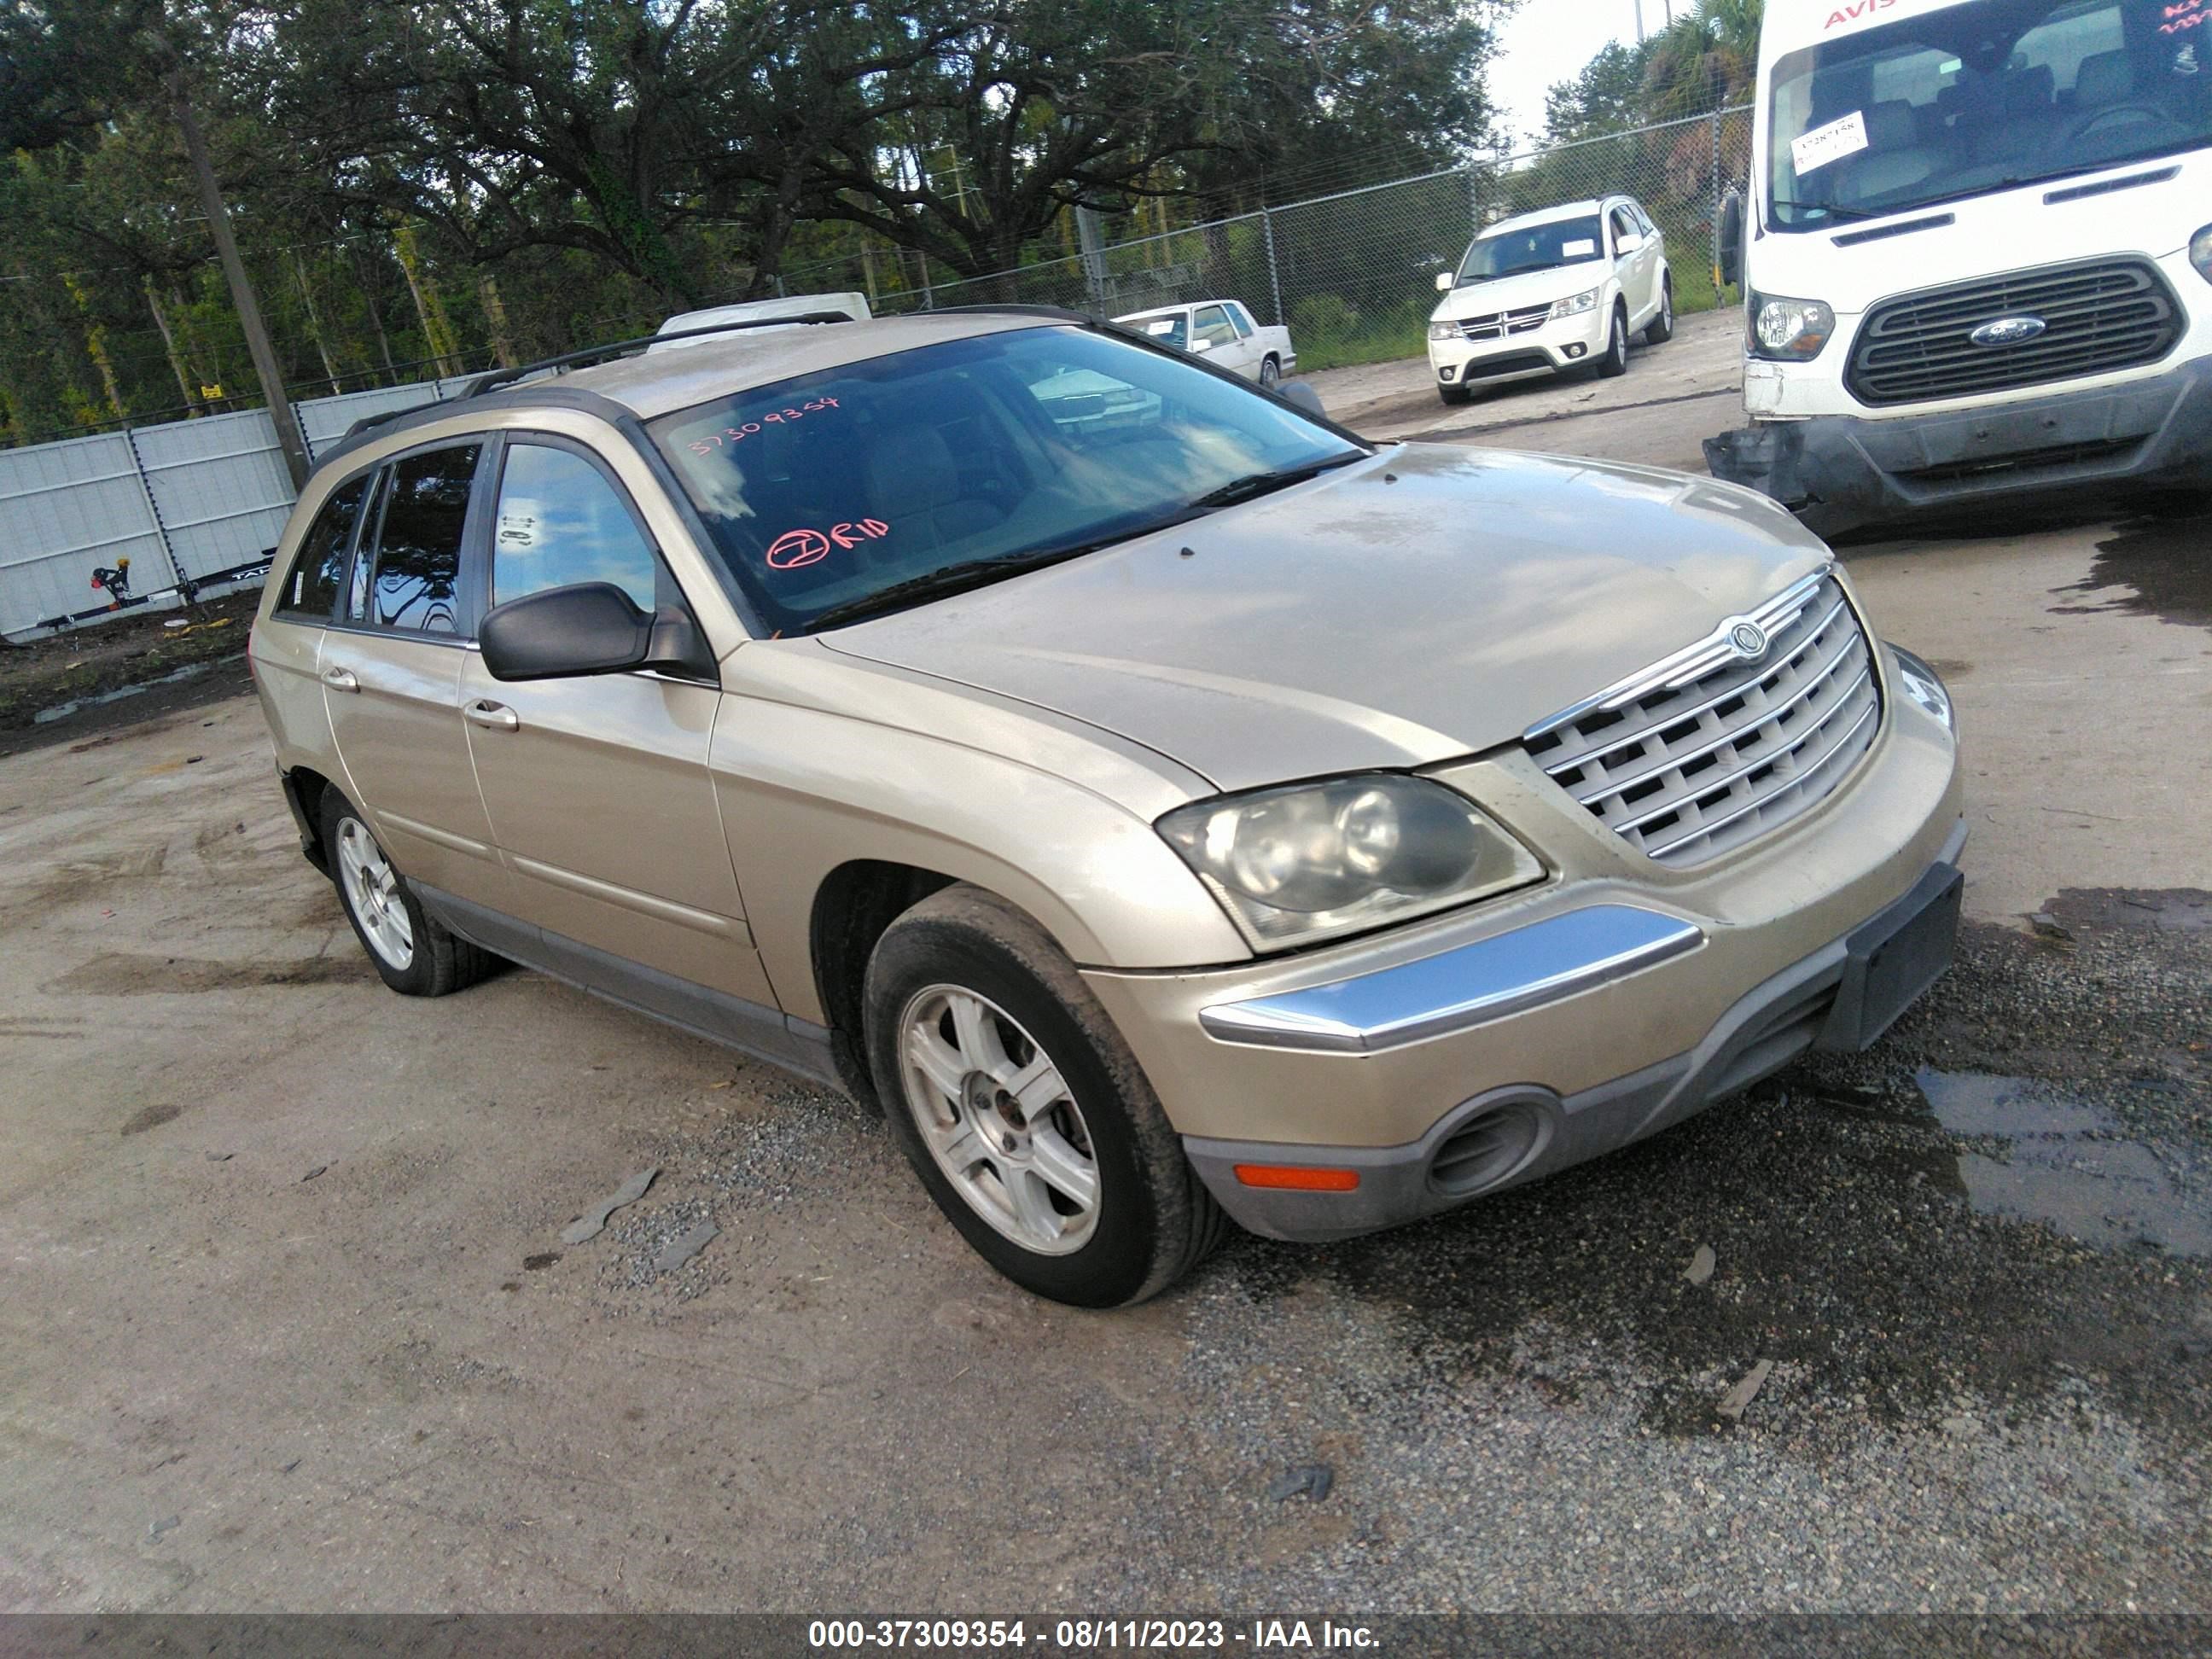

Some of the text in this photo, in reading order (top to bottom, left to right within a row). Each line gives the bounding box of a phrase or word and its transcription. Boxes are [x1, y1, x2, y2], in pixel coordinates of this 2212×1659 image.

[1824, 0, 1896, 29] AVIS
[1988, 323, 2029, 342] Ford
[687, 397, 841, 457] 37309354
